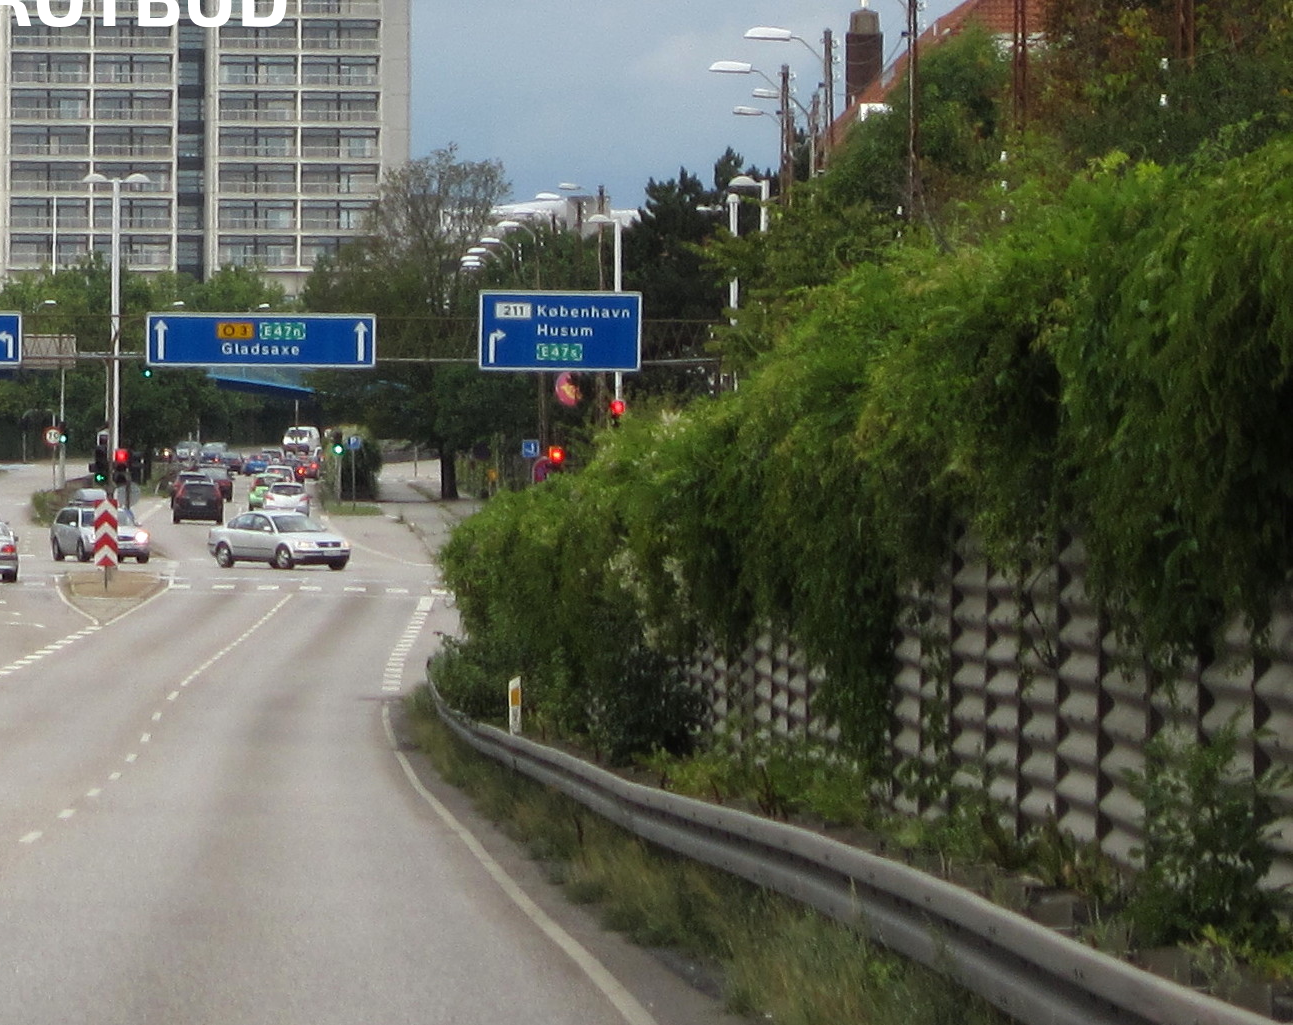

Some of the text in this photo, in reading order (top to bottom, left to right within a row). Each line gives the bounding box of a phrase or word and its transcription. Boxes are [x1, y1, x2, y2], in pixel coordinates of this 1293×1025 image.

[503, 305, 631, 319] 211 København
[536, 323, 594, 337] Husum
[221, 342, 300, 356] Gladsaxe
